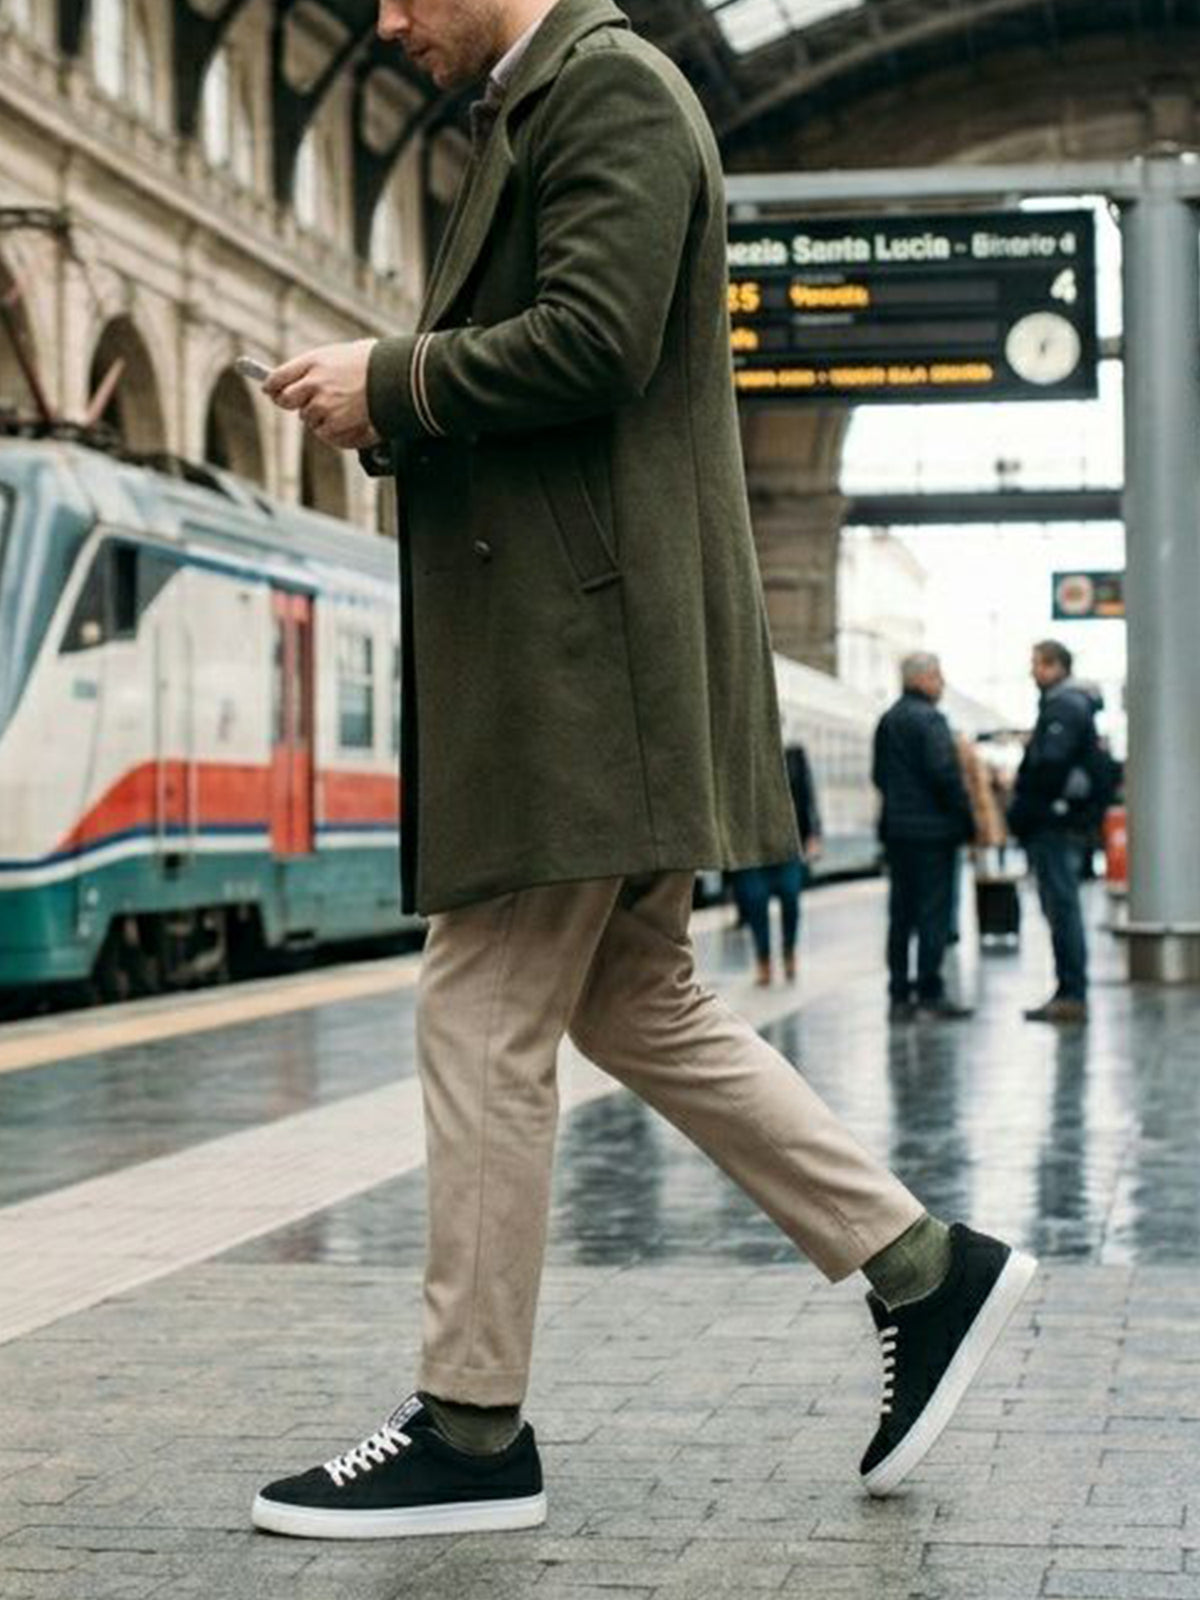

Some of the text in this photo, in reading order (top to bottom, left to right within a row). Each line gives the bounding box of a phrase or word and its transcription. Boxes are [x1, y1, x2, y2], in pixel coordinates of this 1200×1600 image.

[792, 234, 871, 264] Santa
[874, 232, 950, 260] Lucia
[1050, 267, 1077, 304] 4
